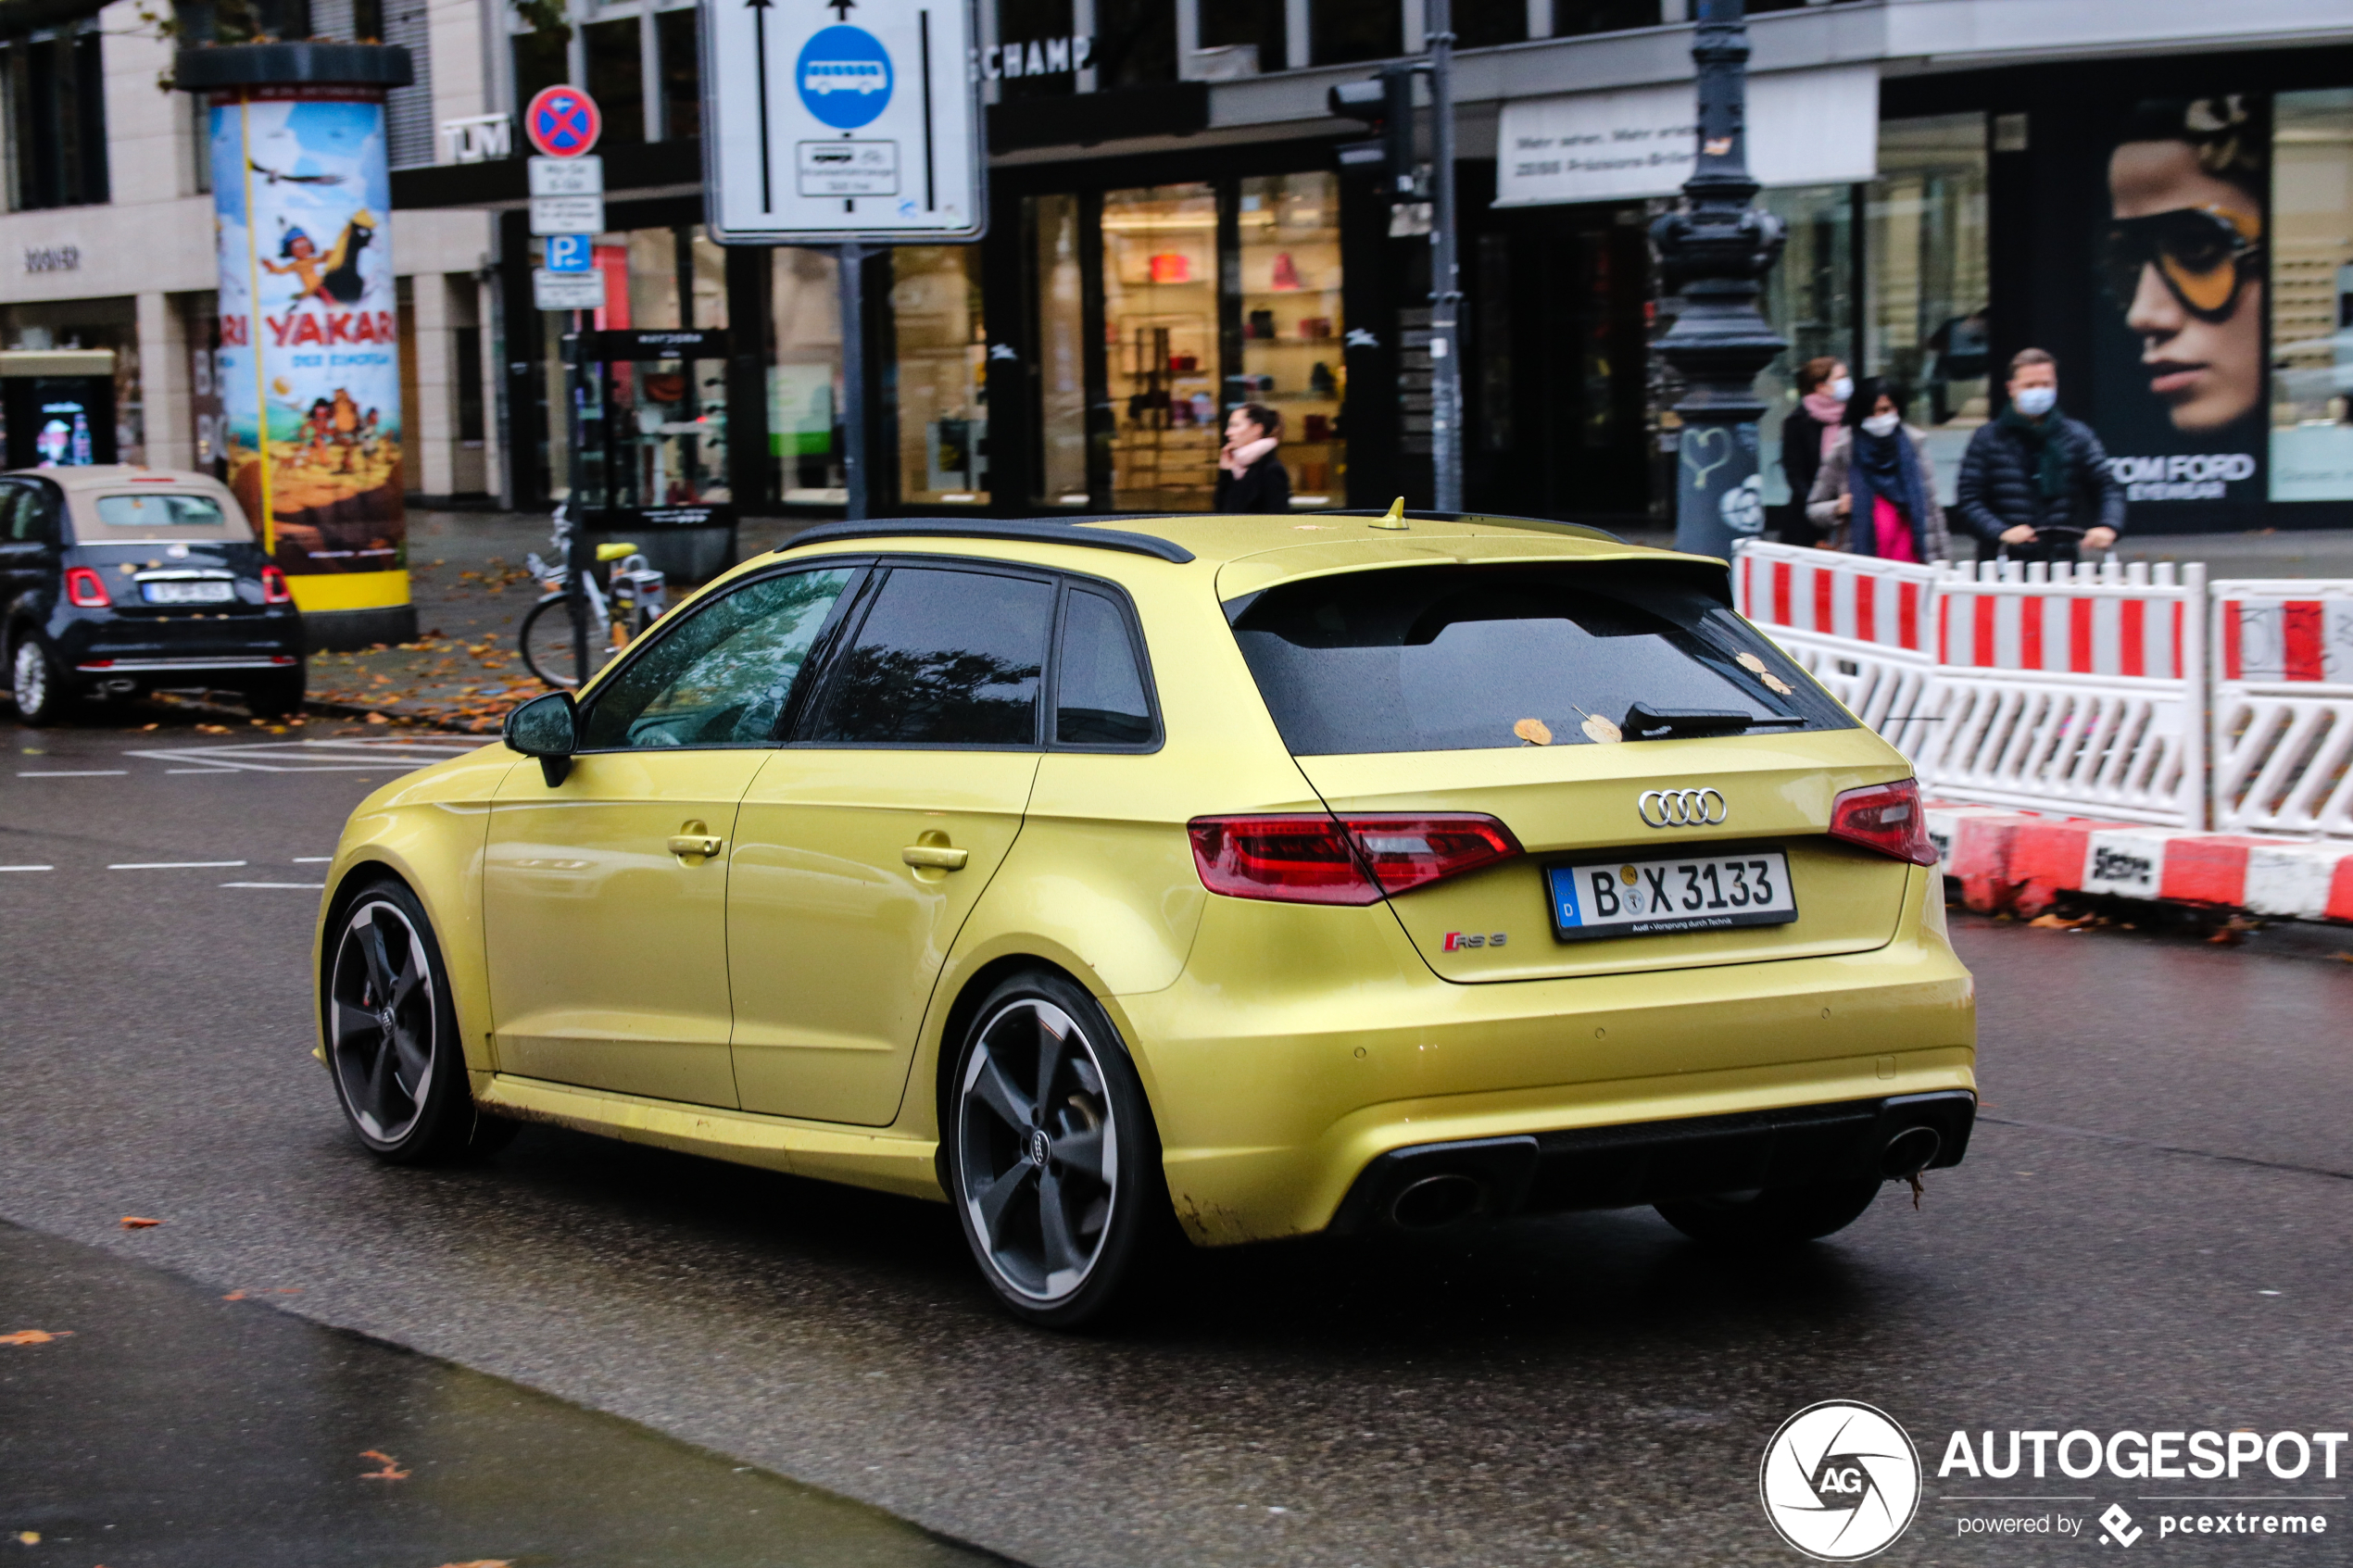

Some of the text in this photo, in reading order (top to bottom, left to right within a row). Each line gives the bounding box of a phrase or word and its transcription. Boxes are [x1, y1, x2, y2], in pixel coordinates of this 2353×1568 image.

[552, 236, 578, 268] P
[2167, 454, 2256, 482] FORD
[2127, 482, 2226, 501] EYEWEAR
[1591, 859, 1773, 917] B X 3133
[1563, 903, 1574, 917] D
[1632, 917, 1733, 933] Audi Vorsprung durch Technik
[1489, 932, 1507, 947] 3
